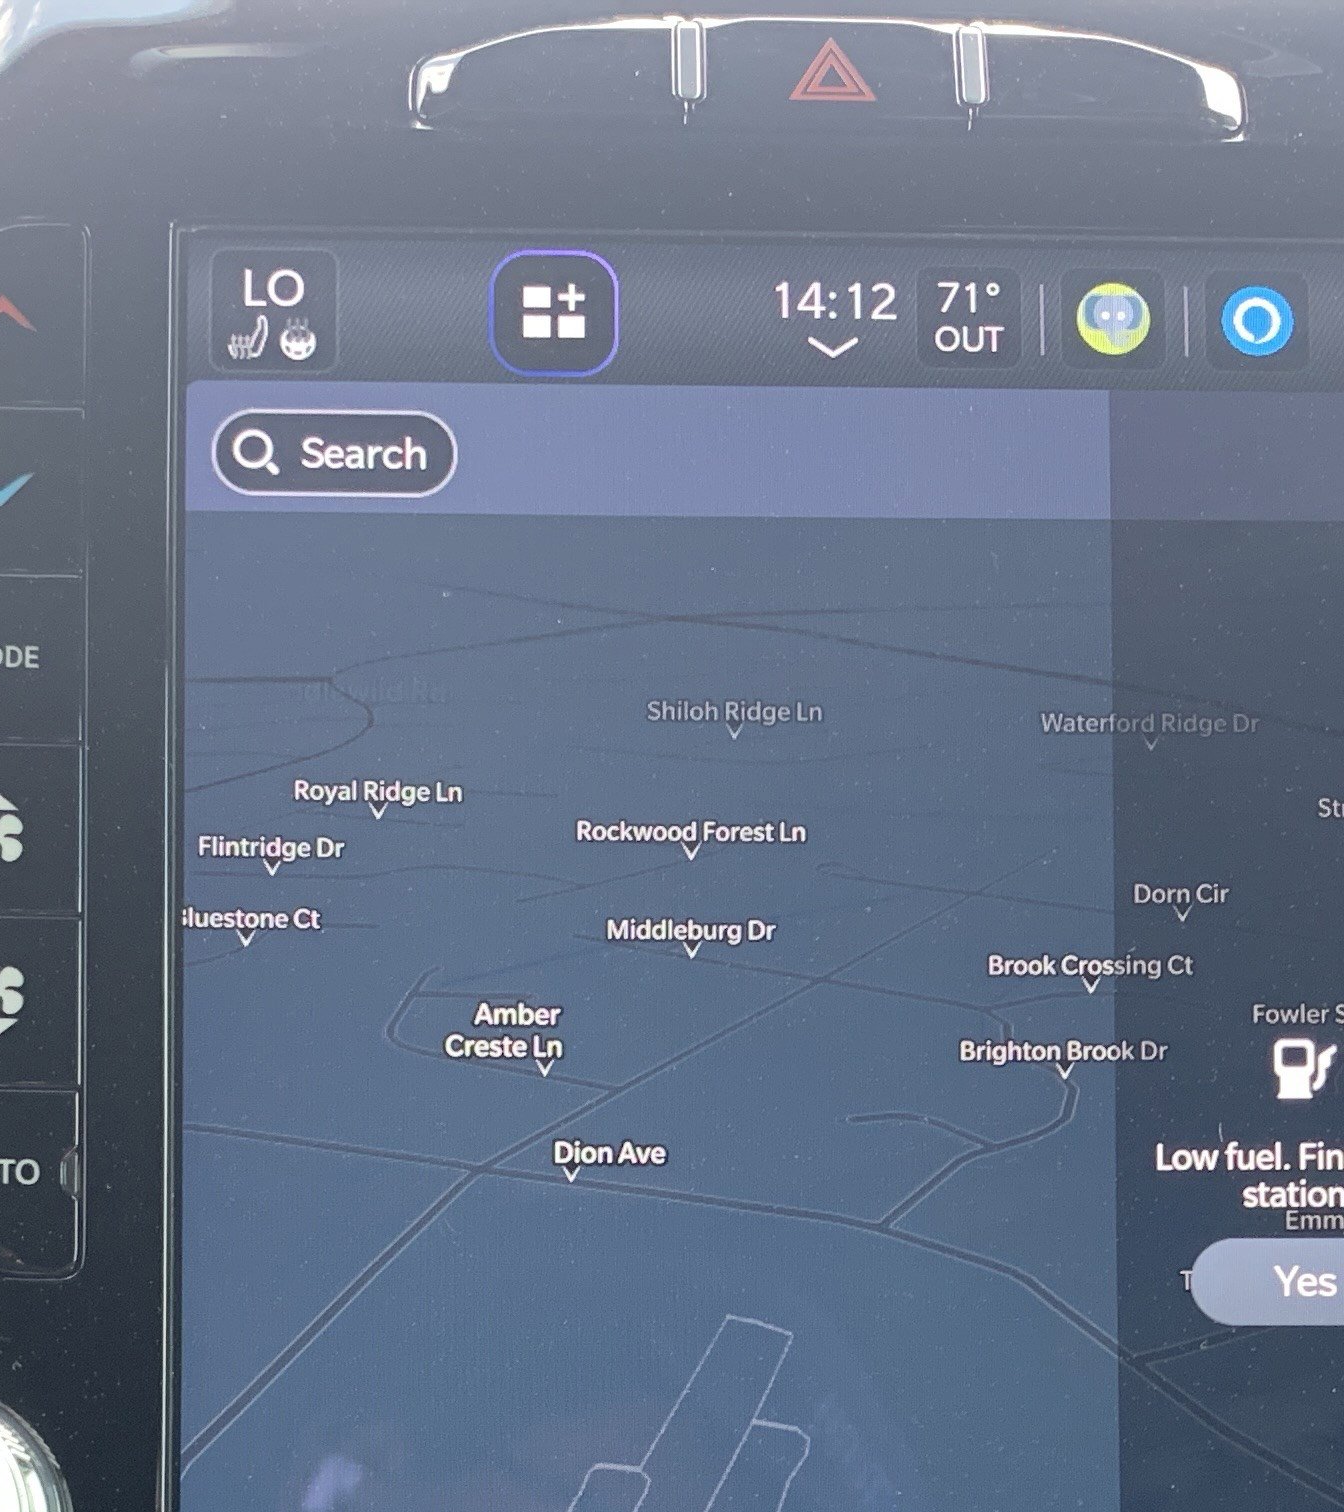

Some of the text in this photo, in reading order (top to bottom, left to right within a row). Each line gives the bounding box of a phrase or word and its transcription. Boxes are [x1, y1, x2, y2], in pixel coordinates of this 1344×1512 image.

[243, 268, 306, 307] LO
[775, 281, 897, 321] 14:12
[935, 326, 1004, 353] OUT
[301, 437, 427, 472] Search
[647, 701, 823, 727] Shiloh Ridge Ln
[1041, 714, 1260, 738] Waterford Ridge Dr
[294, 780, 462, 806] Royal Ridge Ln
[576, 820, 806, 844] Rockwood Forest Ln
[198, 836, 345, 863] Flintridge Dr
[1134, 883, 1229, 904] Dorn Cir
[293, 908, 321, 929] Ct
[606, 919, 776, 946] Middleburg Dr
[988, 954, 1193, 981] Brook Crossing Ct
[474, 1003, 561, 1026] Amber
[1252, 1004, 1329, 1024] Fowler
[445, 1035, 563, 1058] Creste Ln
[959, 1040, 1168, 1066] Brighton Brook Dr
[554, 1141, 666, 1165] Dion Ave
[1156, 1144, 1218, 1171] Low
[1225, 1142, 1292, 1171] fuel.
[1273, 1265, 1338, 1297] Yes
